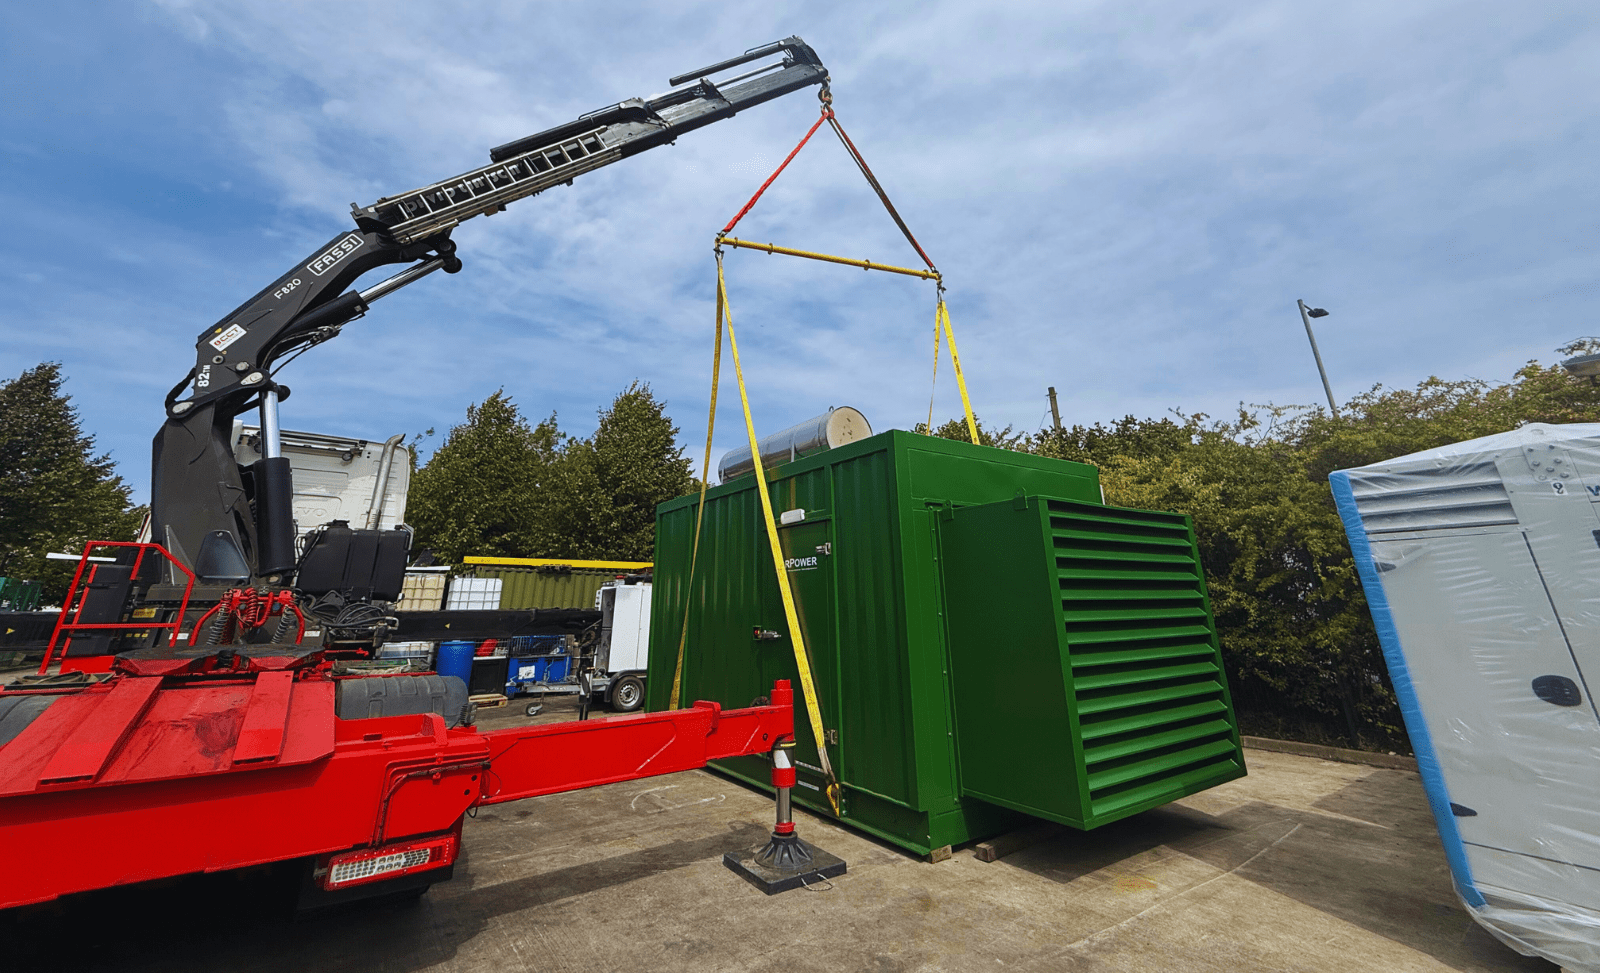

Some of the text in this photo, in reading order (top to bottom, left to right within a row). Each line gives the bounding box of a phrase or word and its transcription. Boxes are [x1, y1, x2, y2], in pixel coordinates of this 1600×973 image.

[313, 238, 358, 271] FASSI
[273, 278, 302, 300] F820
[784, 556, 818, 568] RPOWER
